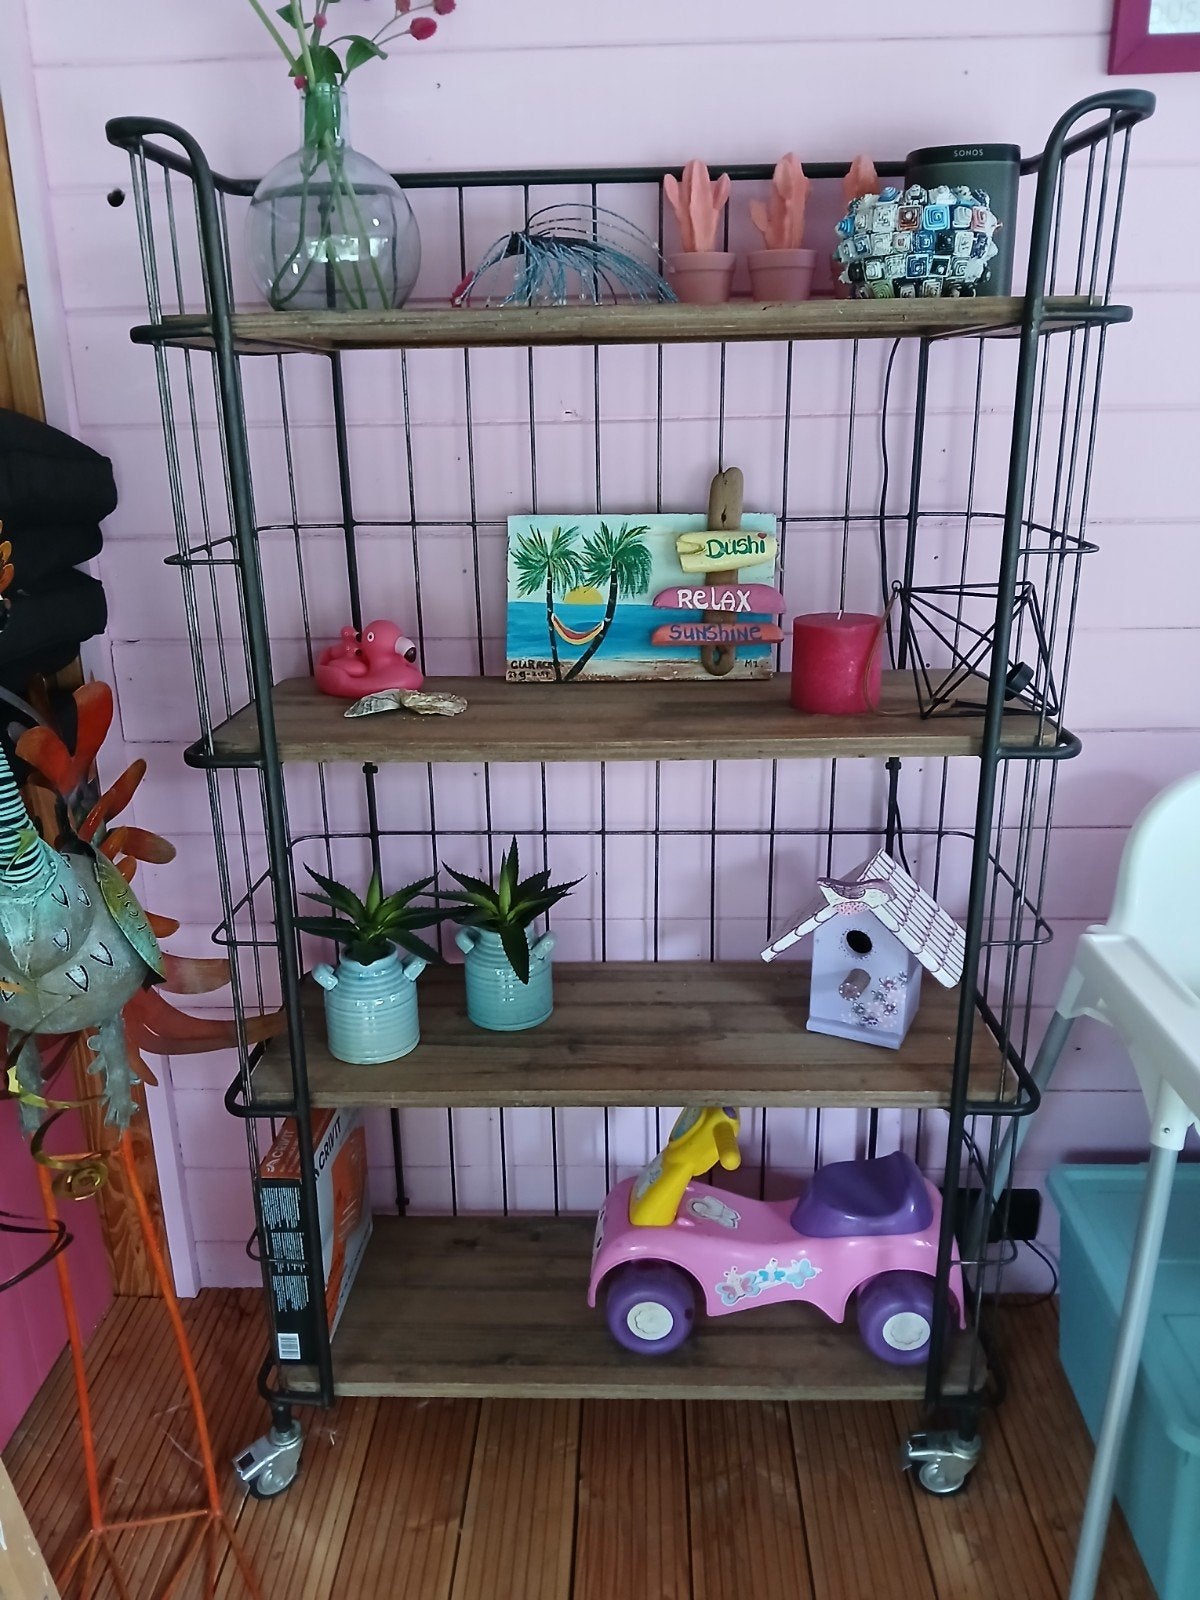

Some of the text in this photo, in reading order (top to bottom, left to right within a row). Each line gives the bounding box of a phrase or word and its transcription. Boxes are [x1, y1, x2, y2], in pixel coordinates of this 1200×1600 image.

[953, 149, 984, 157] SONOS
[705, 533, 767, 558] Dushi
[319, 1116, 341, 1170] CRIVIT
